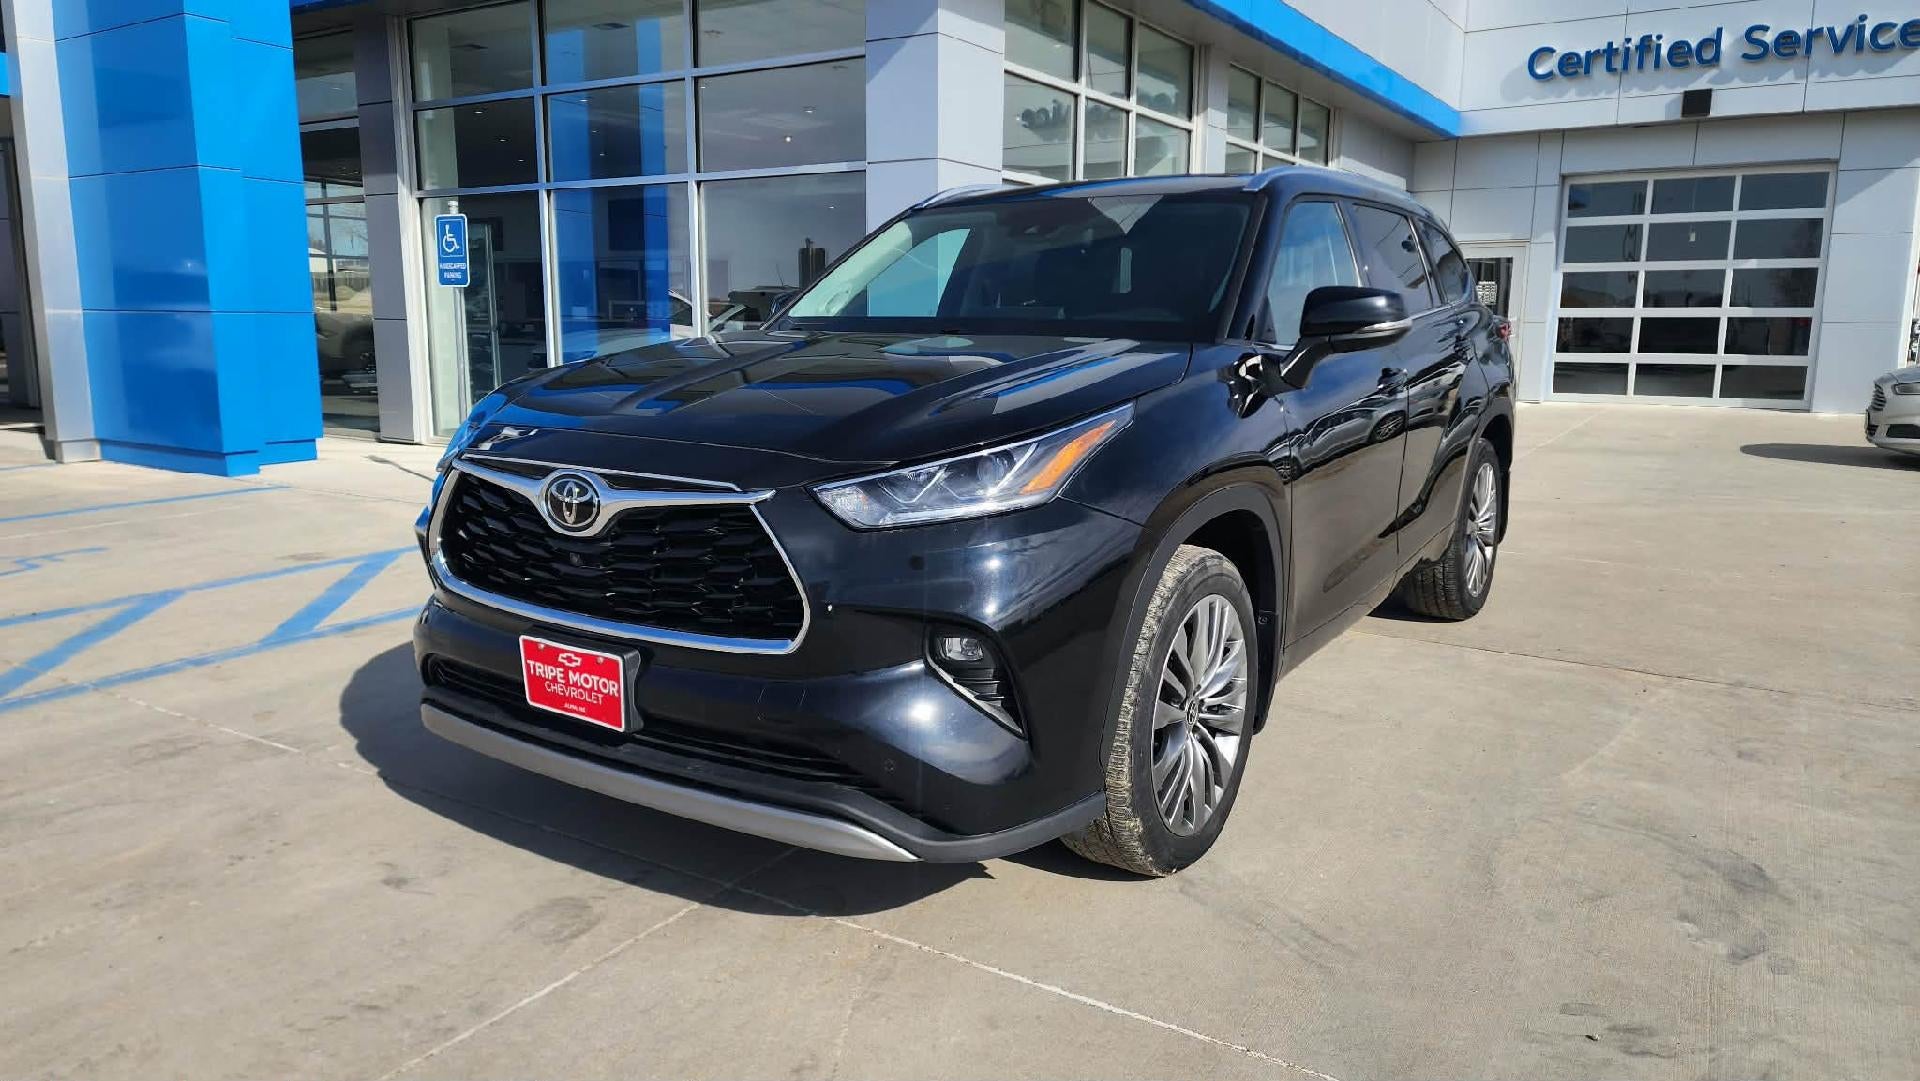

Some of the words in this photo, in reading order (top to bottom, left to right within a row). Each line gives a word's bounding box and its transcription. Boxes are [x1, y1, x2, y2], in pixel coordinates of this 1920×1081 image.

[1527, 27, 1723, 80] Certified
[1741, 14, 1920, 60] Service
[527, 660, 565, 683] TRIPE
[568, 670, 619, 697] MOTOR
[544, 681, 603, 704] CHEVROLET
